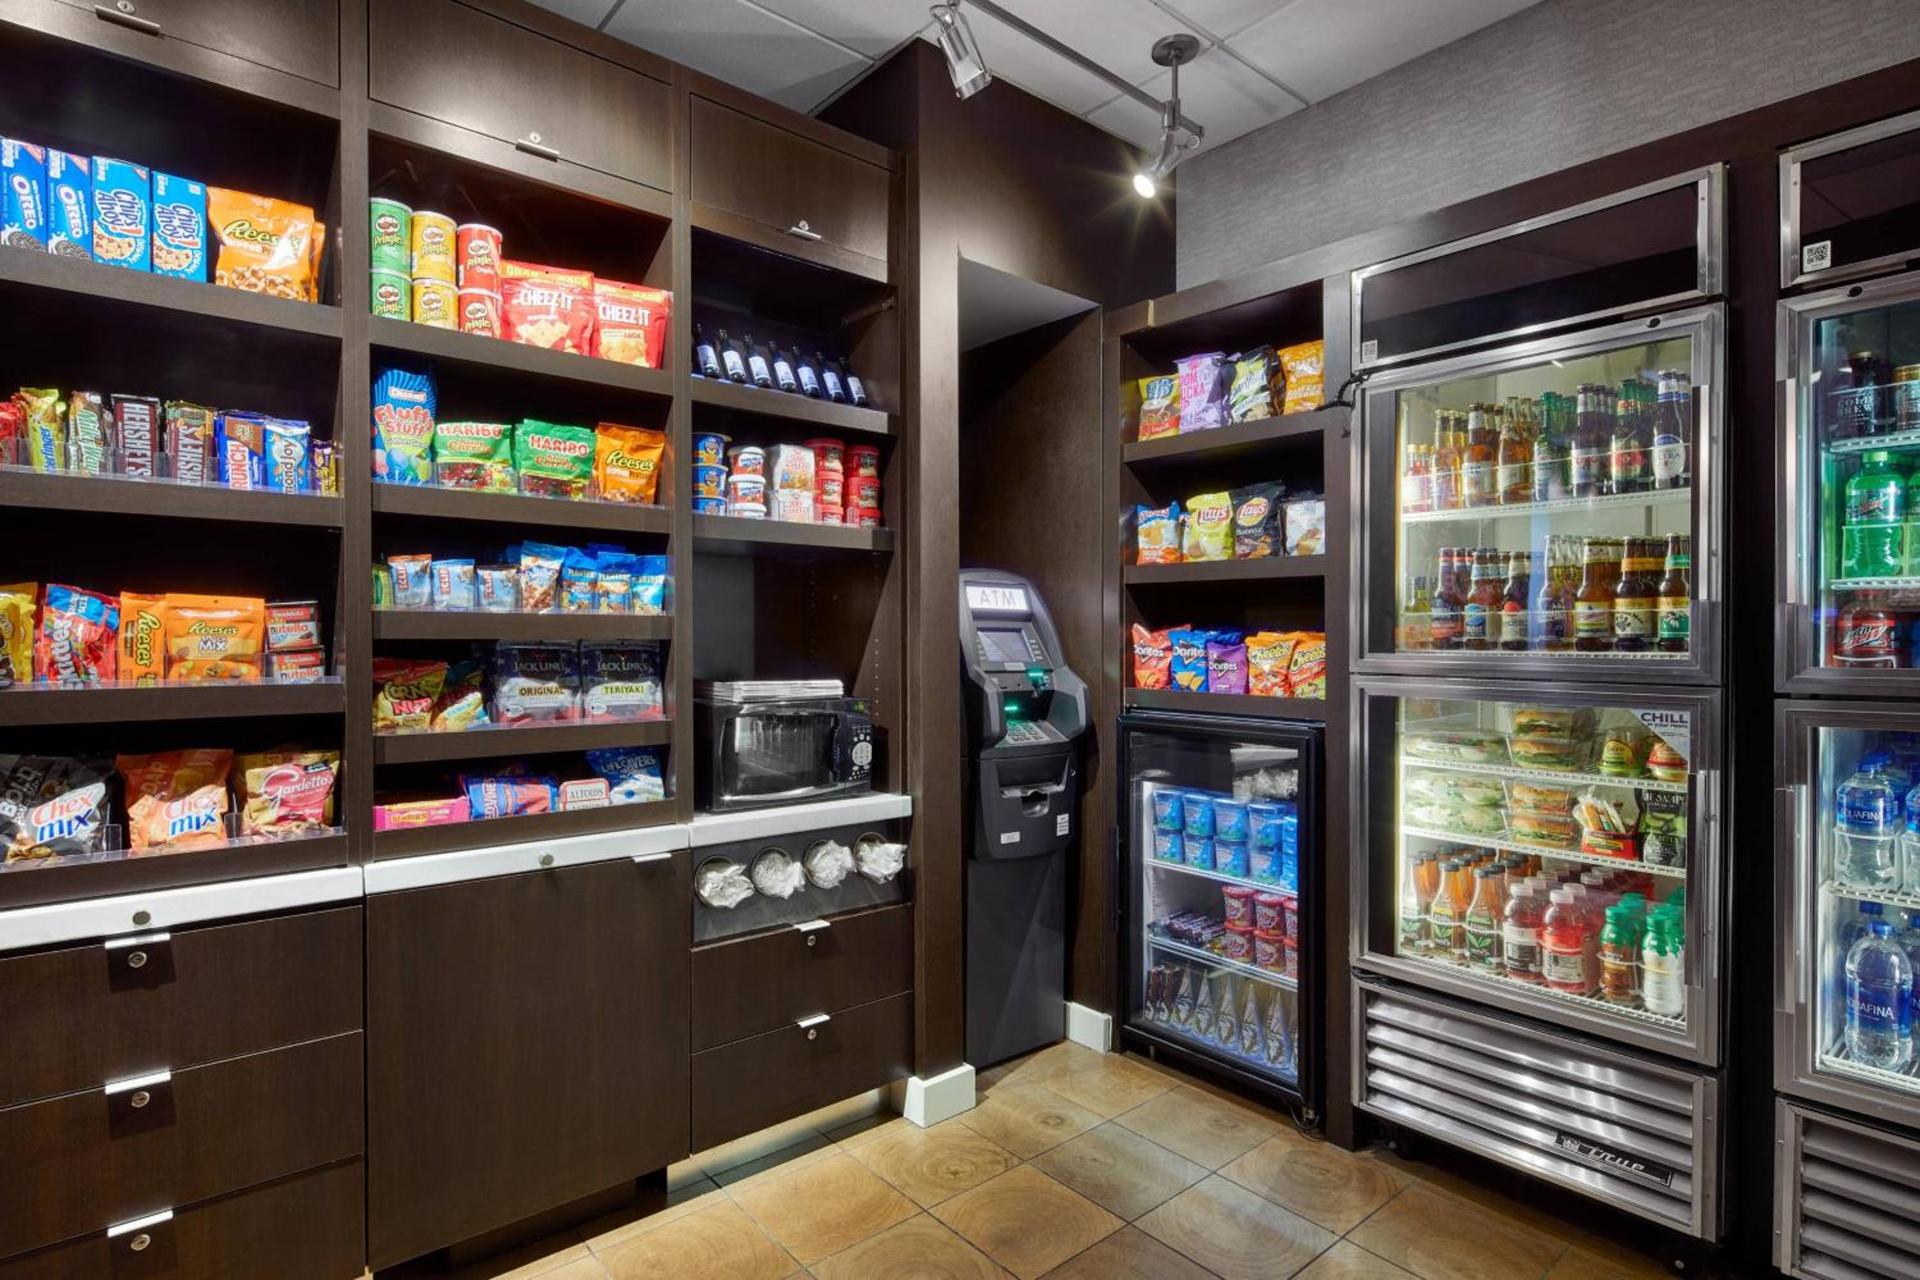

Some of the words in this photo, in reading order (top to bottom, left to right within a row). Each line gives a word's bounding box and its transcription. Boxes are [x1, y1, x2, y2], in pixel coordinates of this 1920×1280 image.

[11, 174, 37, 230] OREO
[113, 190, 139, 228] Chips
[58, 185, 84, 239] OREO
[171, 205, 197, 241] Chips
[438, 424, 503, 438] HARIBO
[124, 402, 153, 481] HERSHEY'S
[530, 434, 589, 457] HARIBO
[606, 450, 655, 471] Reese's
[979, 590, 1018, 607] ATM
[188, 621, 239, 636] Reese's
[271, 624, 309, 636] nutella
[136, 610, 161, 668] Reese's
[1209, 661, 1238, 671] Doritos
[280, 670, 320, 680] nutella
[518, 686, 565, 697] ORIGINAL
[603, 685, 645, 695] TERIYAKI
[1641, 712, 1689, 724] CHILL
